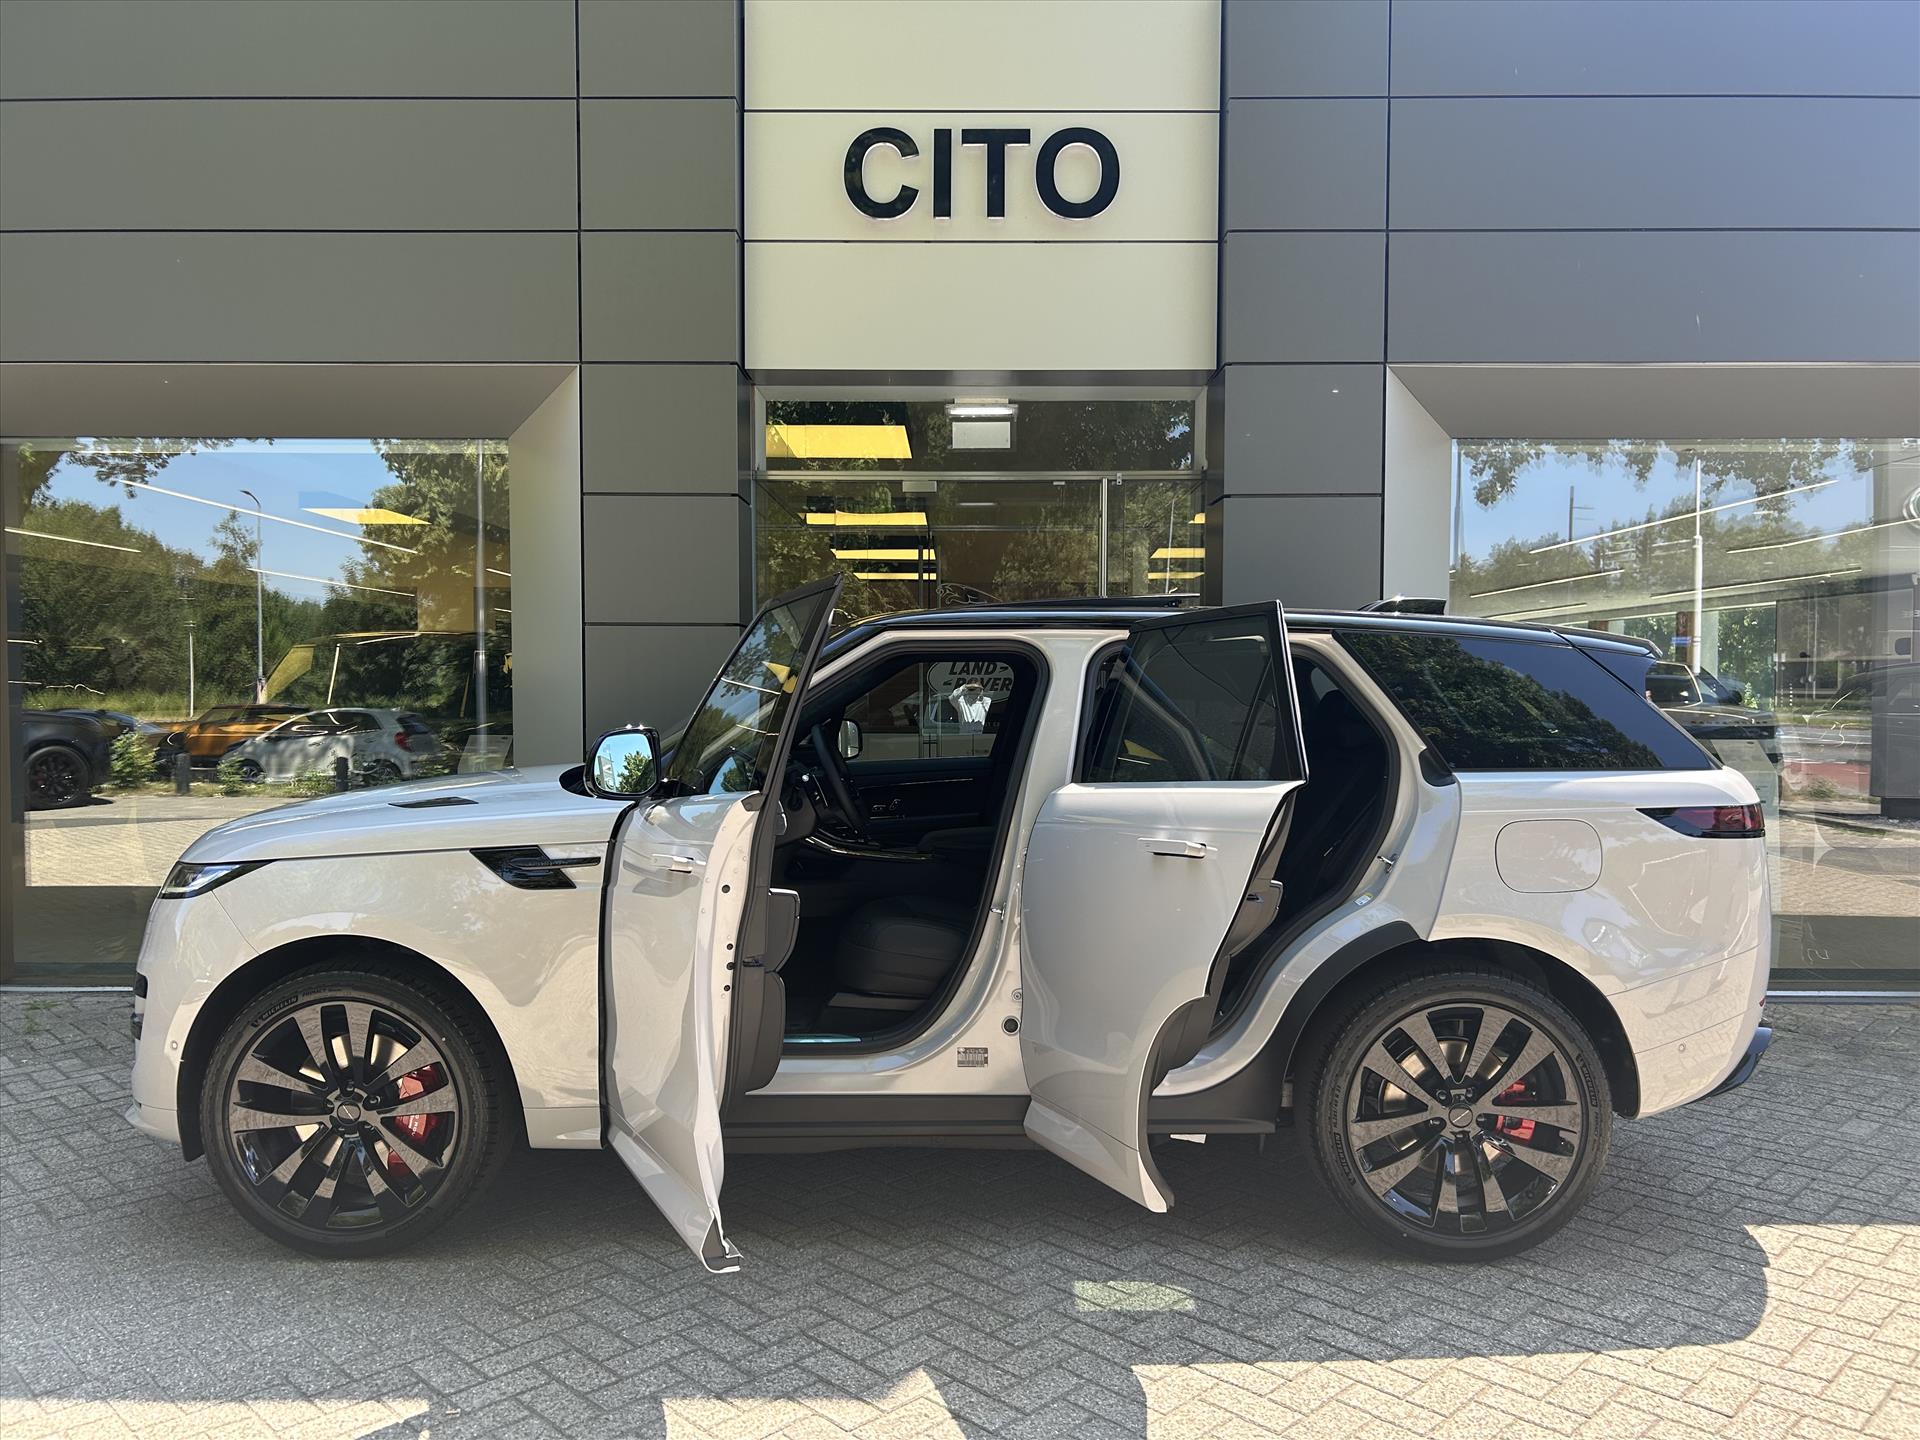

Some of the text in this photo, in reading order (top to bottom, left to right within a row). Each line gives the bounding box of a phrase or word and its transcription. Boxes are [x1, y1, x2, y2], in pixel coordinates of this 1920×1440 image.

[843, 126, 1121, 220] CITO
[949, 661, 998, 675] LAND
[262, 995, 298, 1019] MICHELIN
